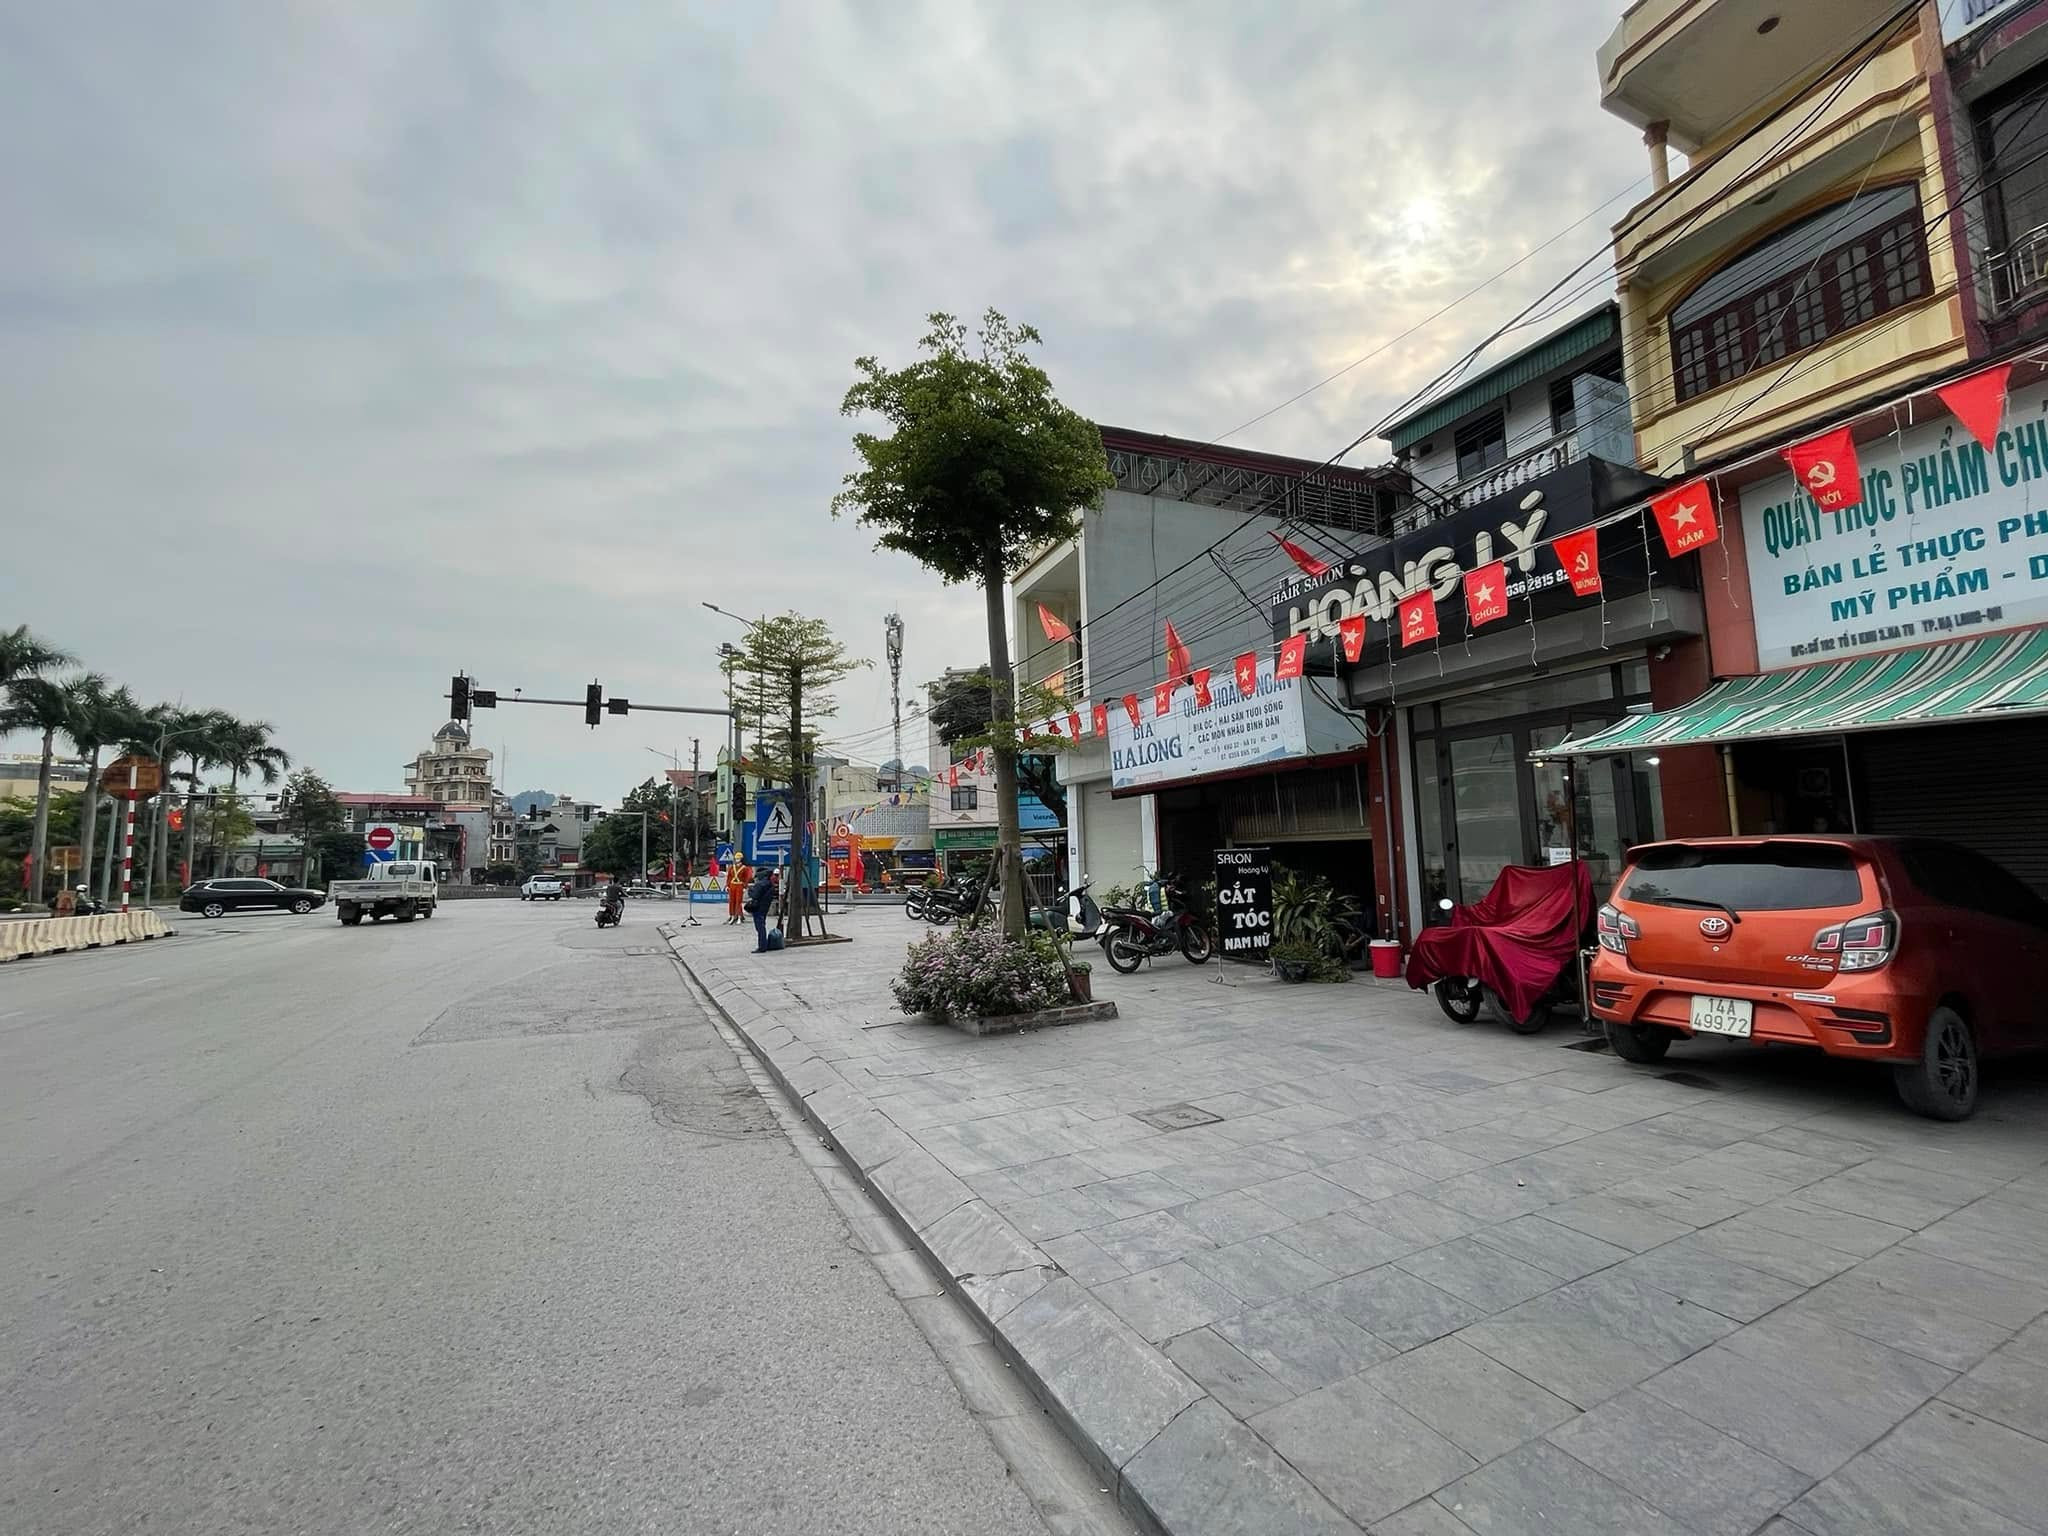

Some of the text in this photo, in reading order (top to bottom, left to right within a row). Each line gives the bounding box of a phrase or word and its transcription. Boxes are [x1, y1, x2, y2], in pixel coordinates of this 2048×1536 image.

[1901, 426, 1990, 515] PHẨM
[1677, 529, 1705, 548] NĂM
[1783, 564, 1842, 596] BÁN
[1853, 543, 1888, 579] LẺ
[1896, 527, 1985, 567] THỰC
[1271, 563, 1345, 606] HAIR SALON
[1289, 546, 1461, 643] HOÀNG
[1506, 579, 1526, 598] 036
[1831, 589, 1876, 622] MỸ
[1888, 566, 1990, 610] PHẨM
[1474, 605, 1501, 622] CHÚC
[1214, 680, 1253, 709] HOÀ
[1133, 722, 1154, 741] BIA
[1217, 853, 1252, 865] SALON
[1219, 880, 1256, 905] CẮT
[1232, 907, 1270, 929] TÓC
[1225, 932, 1271, 951] NAM NỮ
[1708, 998, 1736, 1016] 14A
[1694, 1012, 1749, 1035] 499.72
